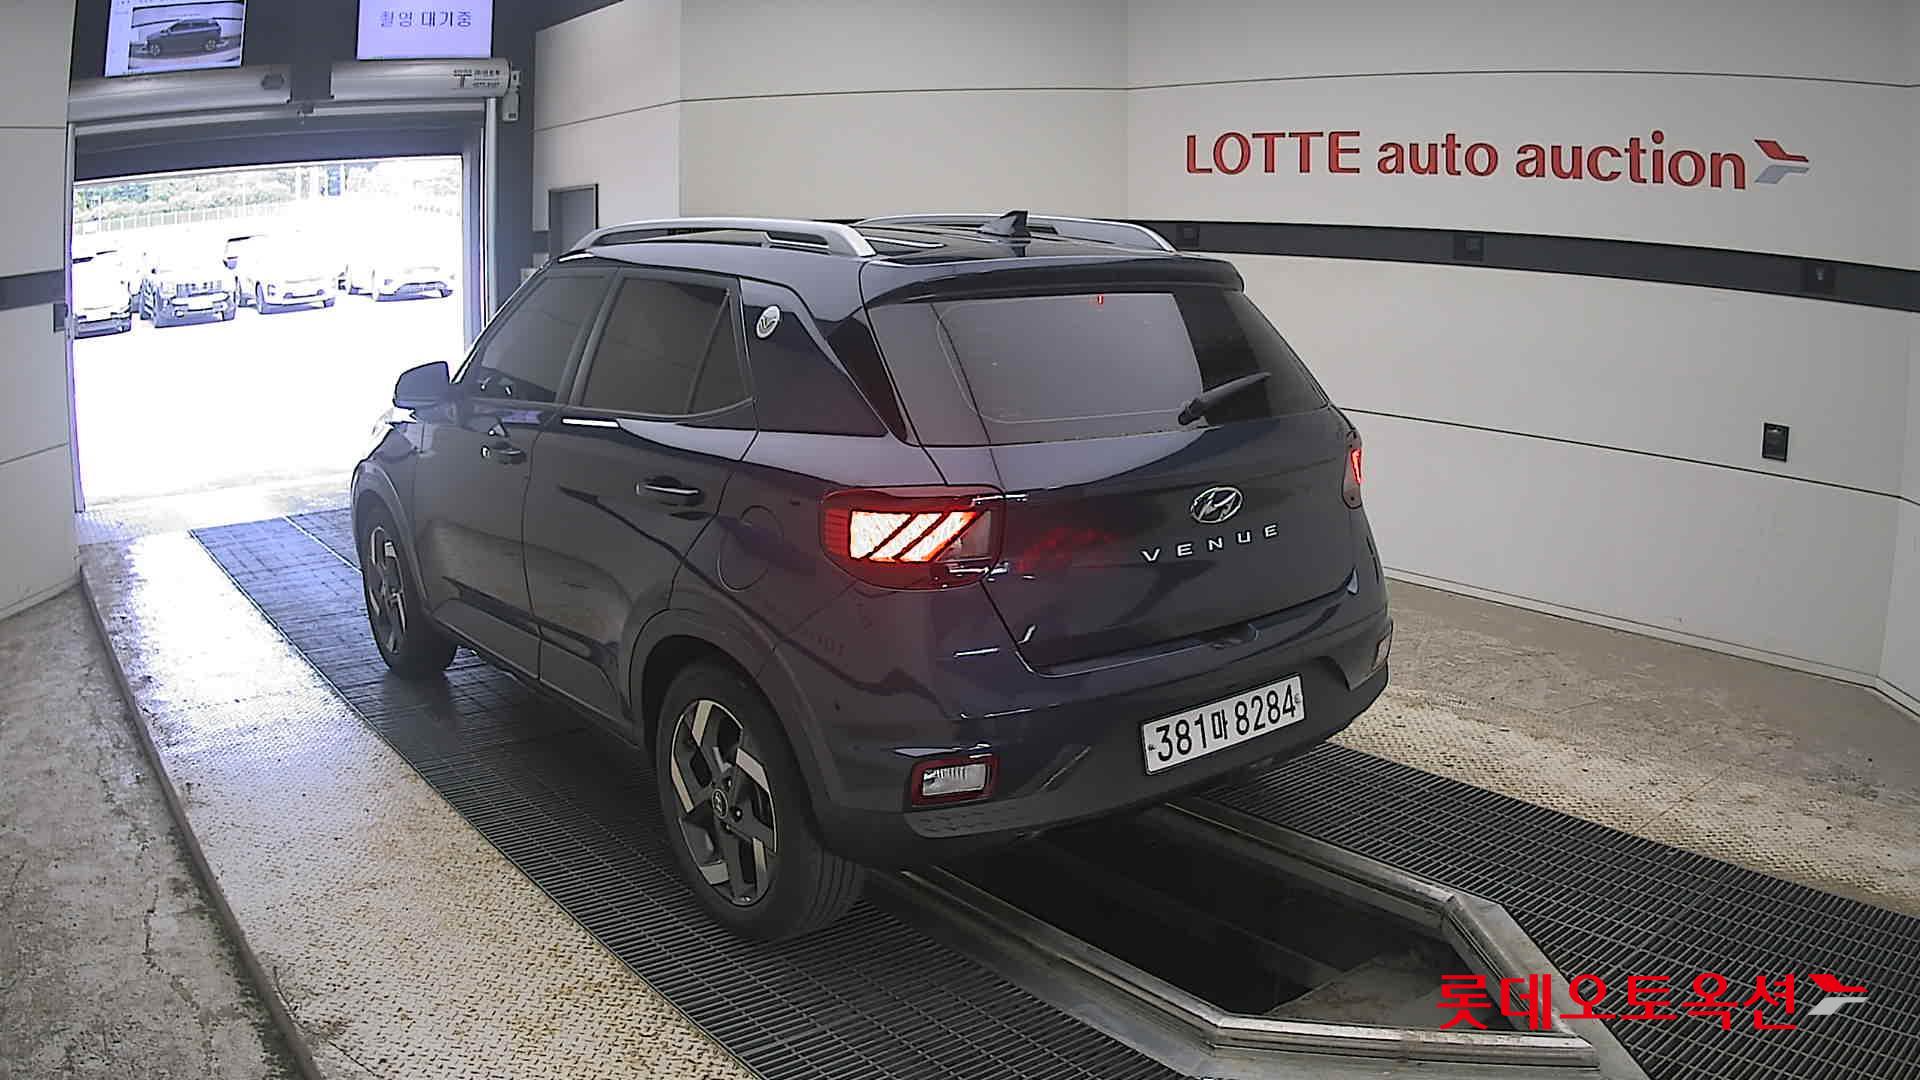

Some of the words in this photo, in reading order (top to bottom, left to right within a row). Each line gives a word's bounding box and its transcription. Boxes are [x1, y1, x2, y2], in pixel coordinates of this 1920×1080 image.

[421, 10, 472, 28] 대기중
[1186, 131, 1361, 175] LOTTE
[1378, 133, 1498, 177] auto
[1516, 131, 1746, 190] auction
[1142, 523, 1278, 562] VENUE
